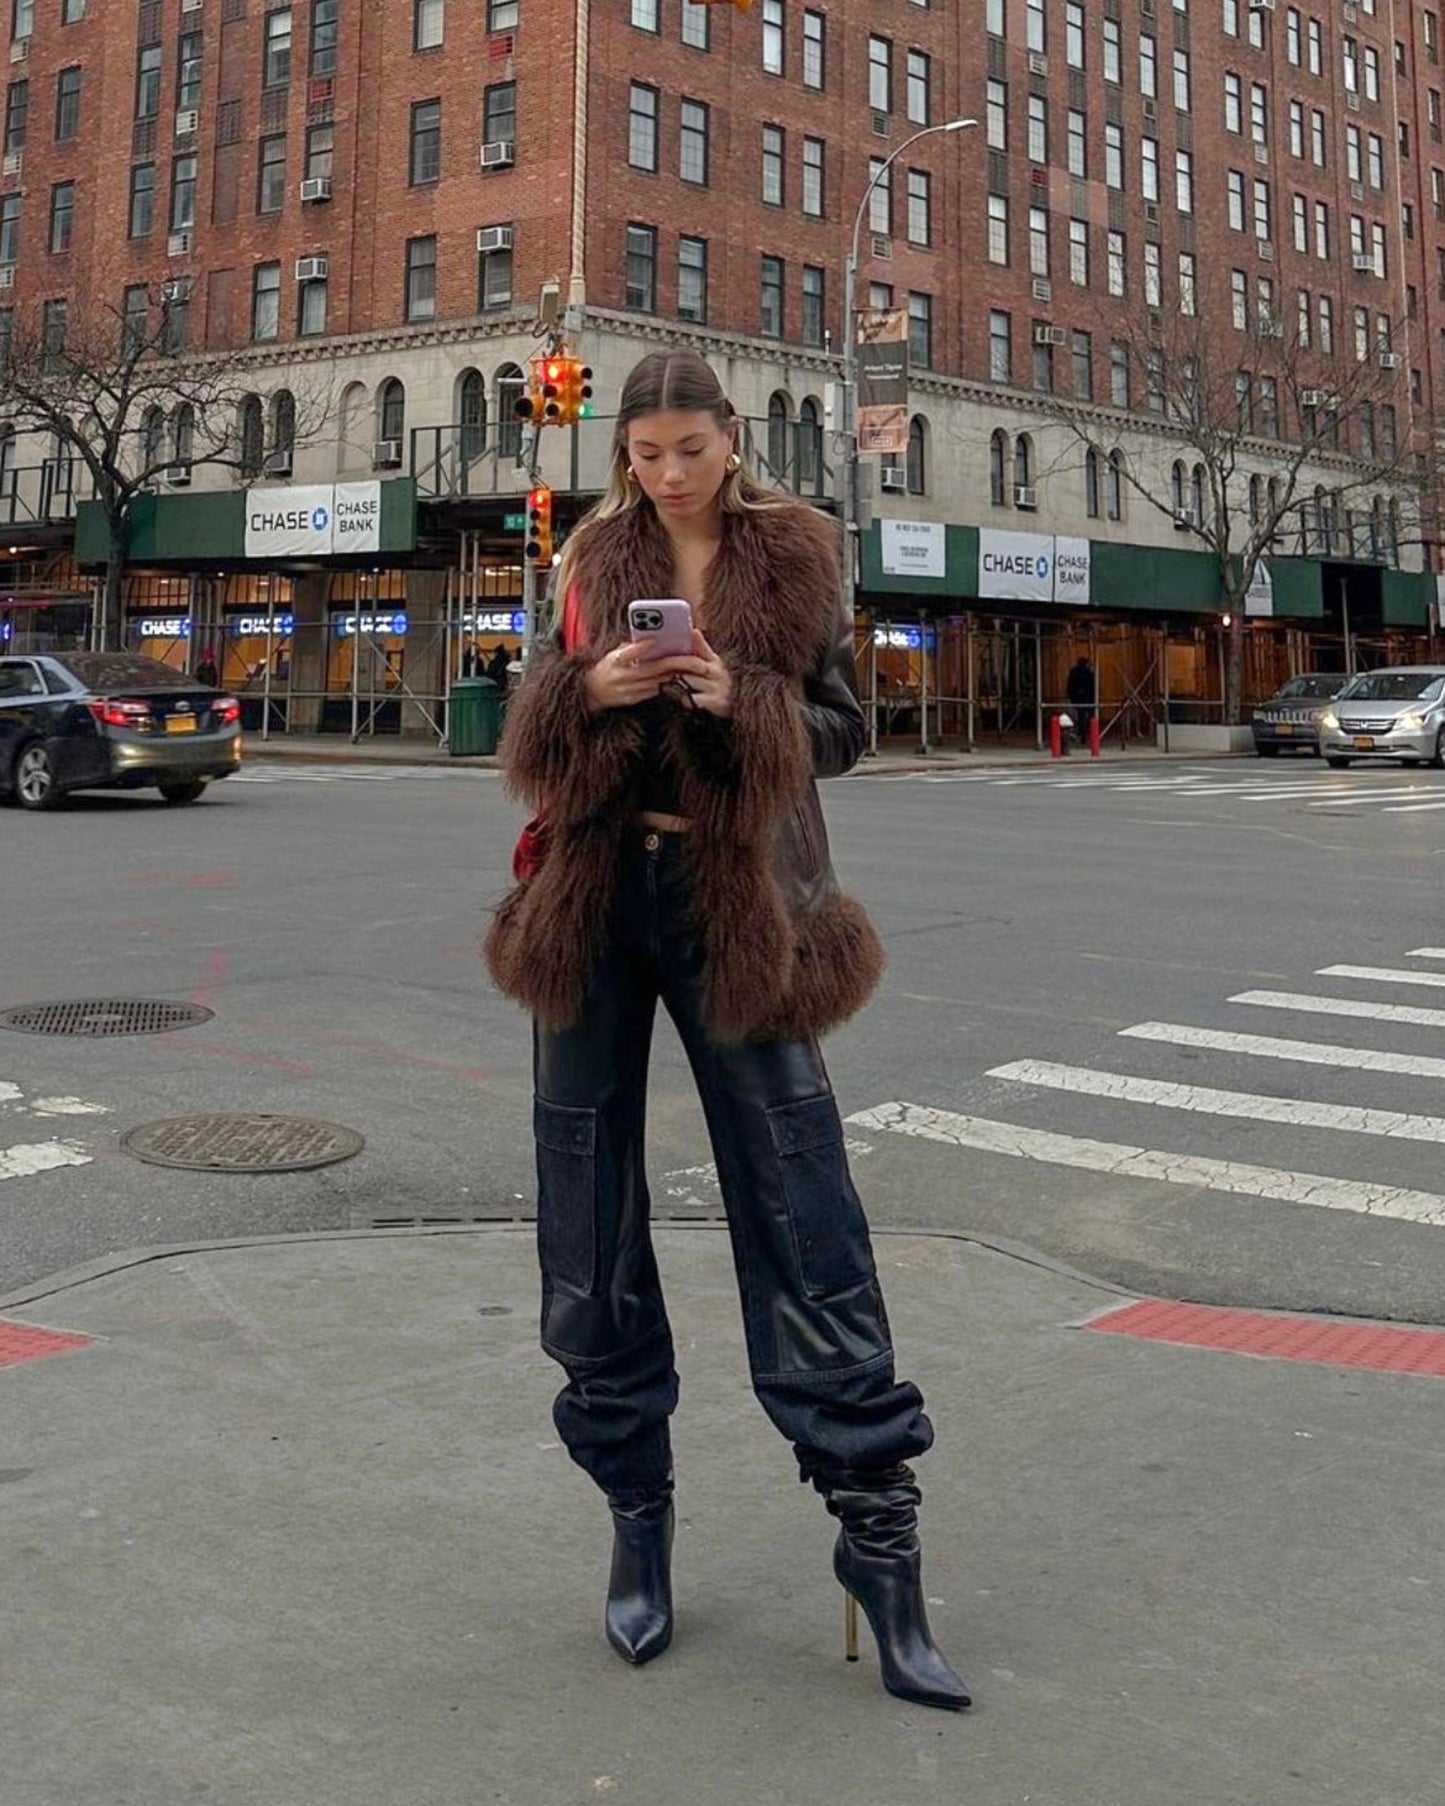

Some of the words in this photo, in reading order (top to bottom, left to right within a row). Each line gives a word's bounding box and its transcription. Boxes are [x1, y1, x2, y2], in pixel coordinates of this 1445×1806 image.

[337, 500, 378, 516] CHASE
[250, 510, 309, 532] CHASE
[339, 519, 374, 533] BANK
[983, 553, 1034, 575] CHASE
[1057, 554, 1088, 570] CHASE
[1060, 571, 1086, 586] BANK
[141, 619, 181, 636] CHASE
